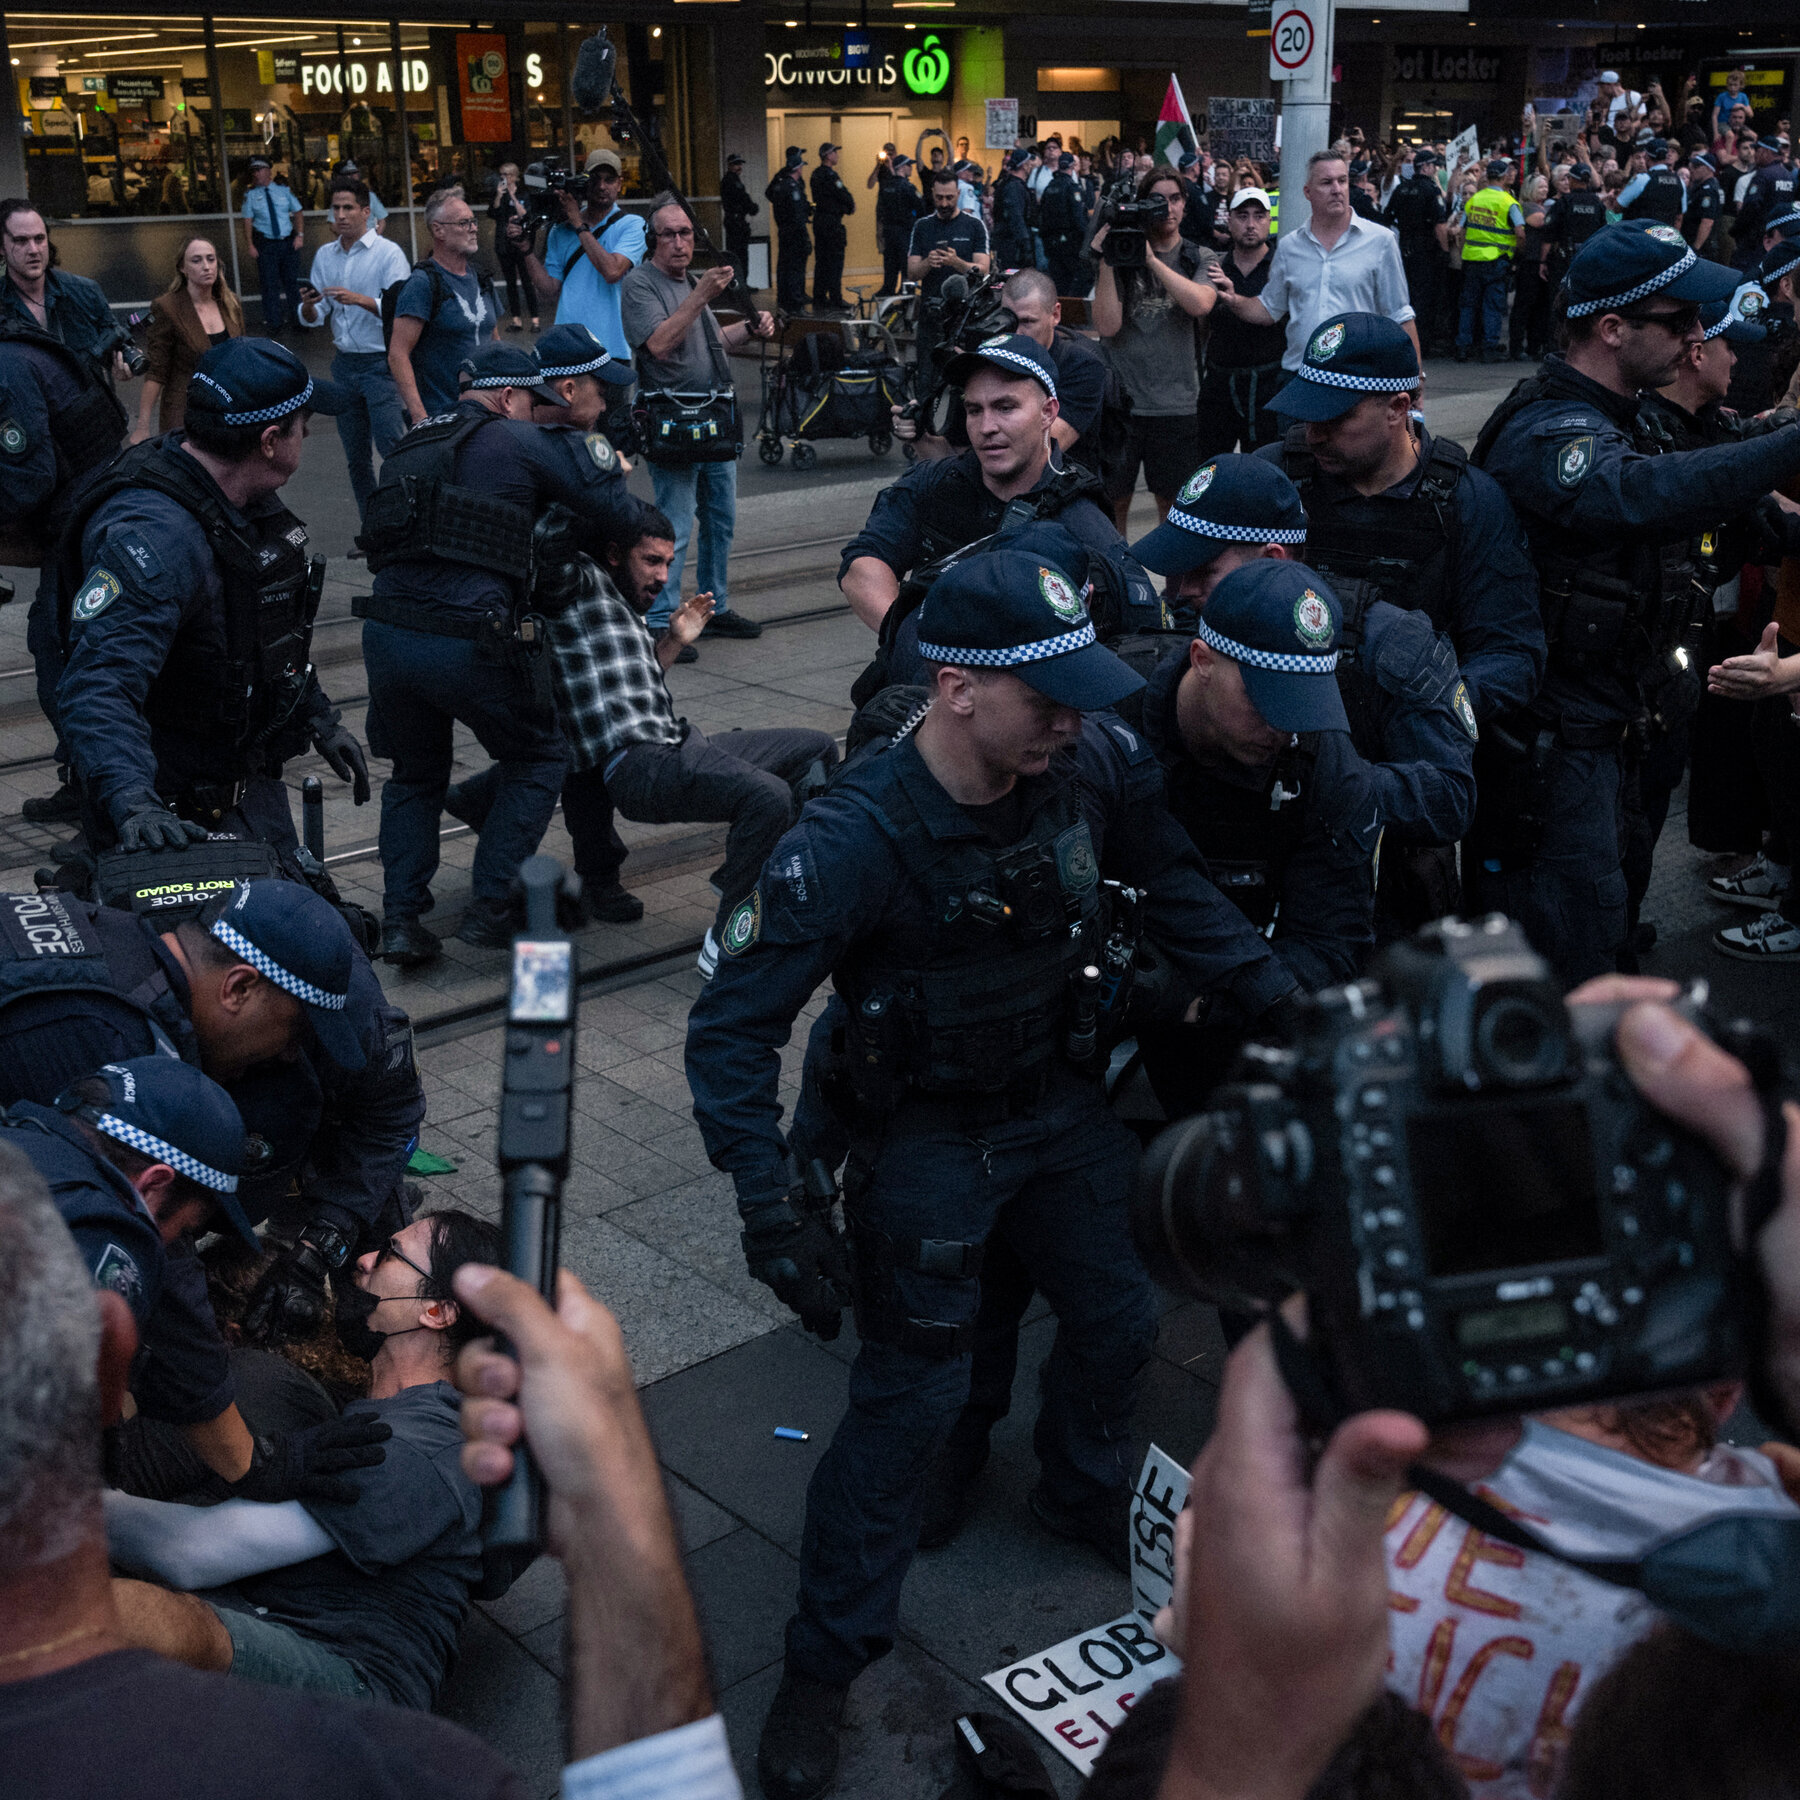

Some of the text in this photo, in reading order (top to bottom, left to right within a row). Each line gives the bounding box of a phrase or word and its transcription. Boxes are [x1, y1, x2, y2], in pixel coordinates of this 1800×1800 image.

[1281, 27, 1305, 52] 20
[1432, 47, 1500, 80] Locker
[1635, 45, 1685, 62] Locker
[301, 63, 367, 95] FOOD
[1573, 204, 1595, 214] POLICE
[214, 383, 233, 403] FORCE
[136, 546, 150, 559] SLY
[135, 880, 235, 898] RIOT SQUAD
[8, 895, 70, 954] POLICE
[122, 1072, 136, 1103] FORCE
